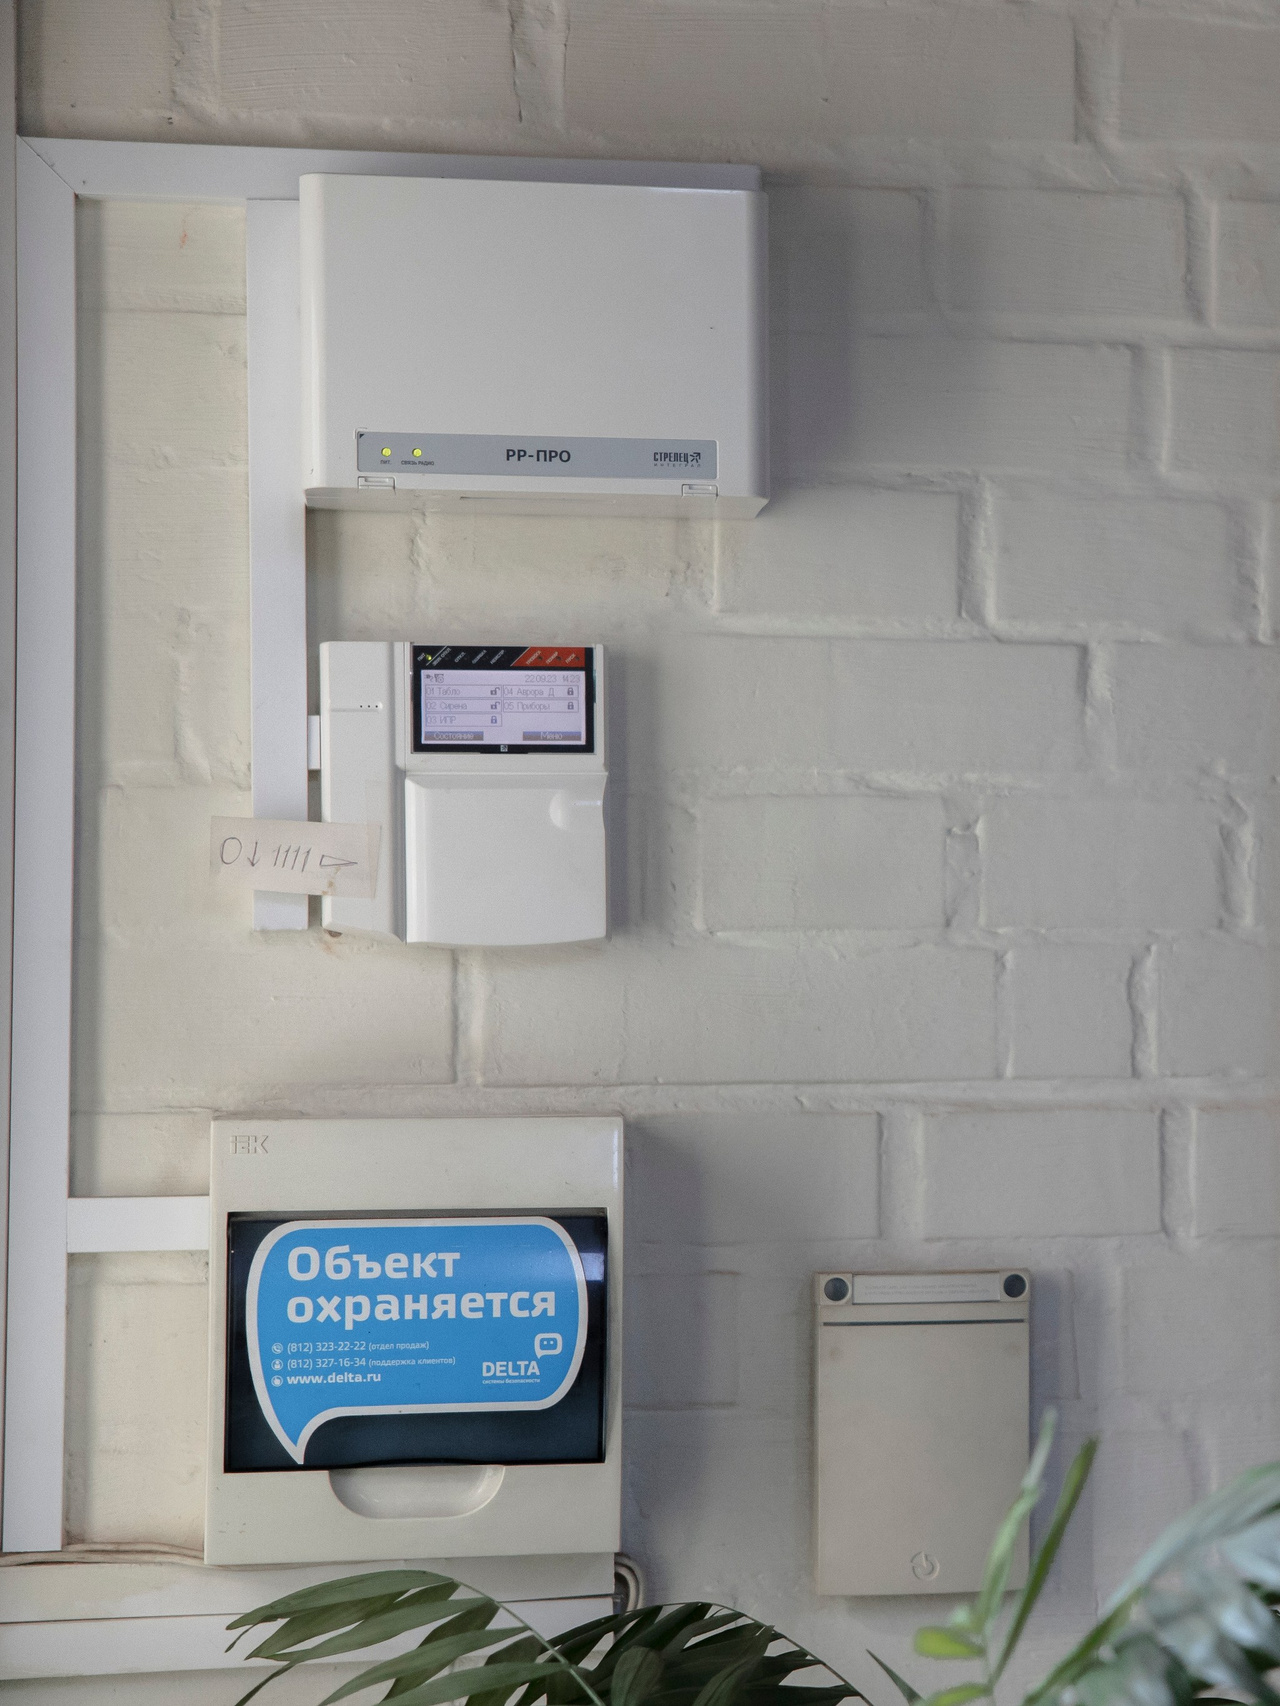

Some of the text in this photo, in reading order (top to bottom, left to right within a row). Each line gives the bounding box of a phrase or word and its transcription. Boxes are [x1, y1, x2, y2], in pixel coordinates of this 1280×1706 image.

[505, 449, 571, 463] РР-ПРО
[287, 1245, 461, 1281] Объект
[287, 1291, 556, 1331] охраняется
[287, 1340, 430, 1355] (812) 323-22-22 (отдел продаж)
[287, 1356, 456, 1372] (812) 327-16-34 (поддержка клиентов)
[482, 1360, 540, 1377] DELTA
[287, 1371, 382, 1385] www.delta.ru
